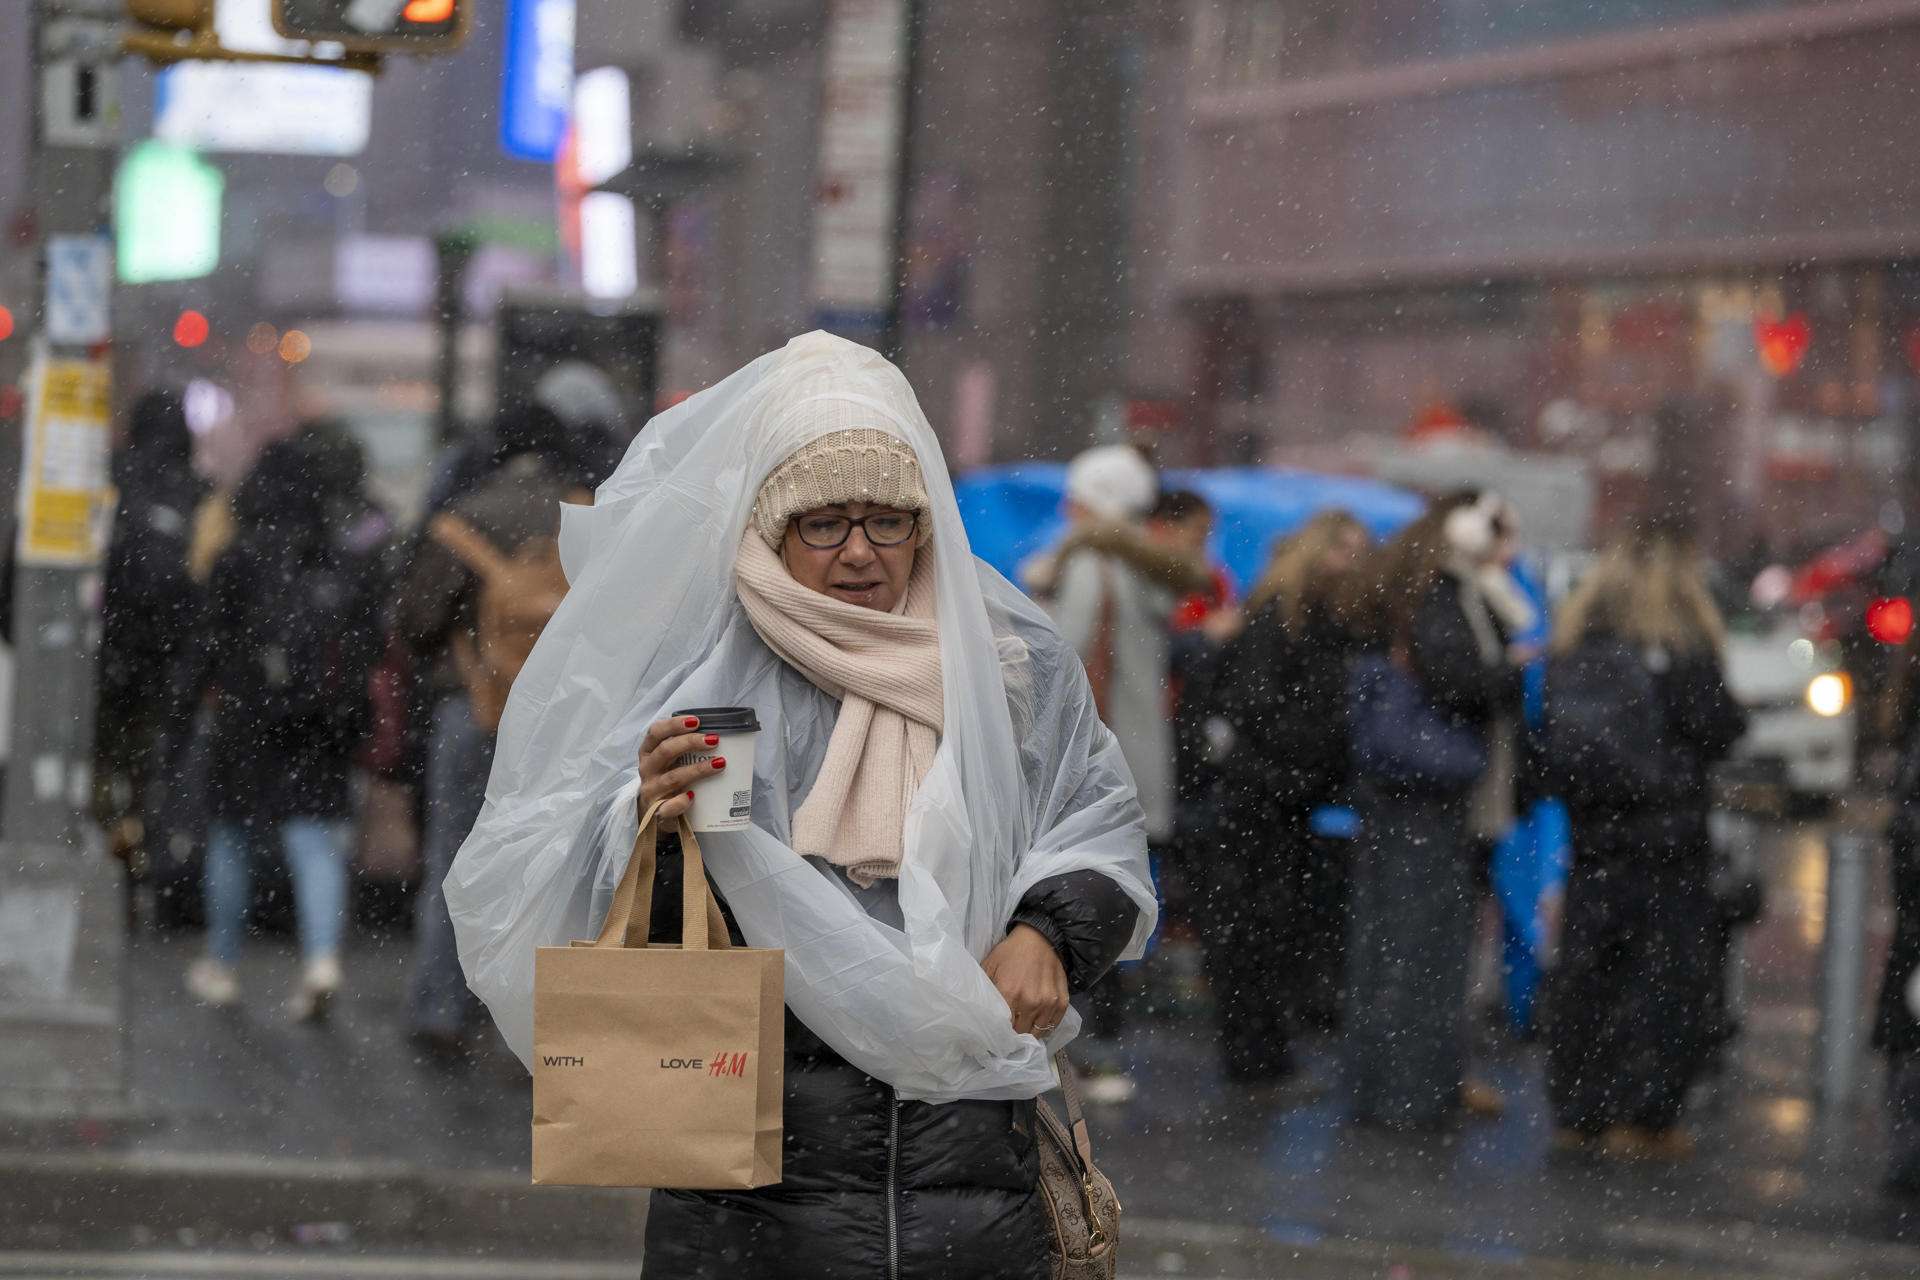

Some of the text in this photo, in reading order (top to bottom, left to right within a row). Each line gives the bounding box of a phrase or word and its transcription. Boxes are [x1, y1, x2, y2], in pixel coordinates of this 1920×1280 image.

[543, 1051, 748, 1078] WITH LOVE H&M
